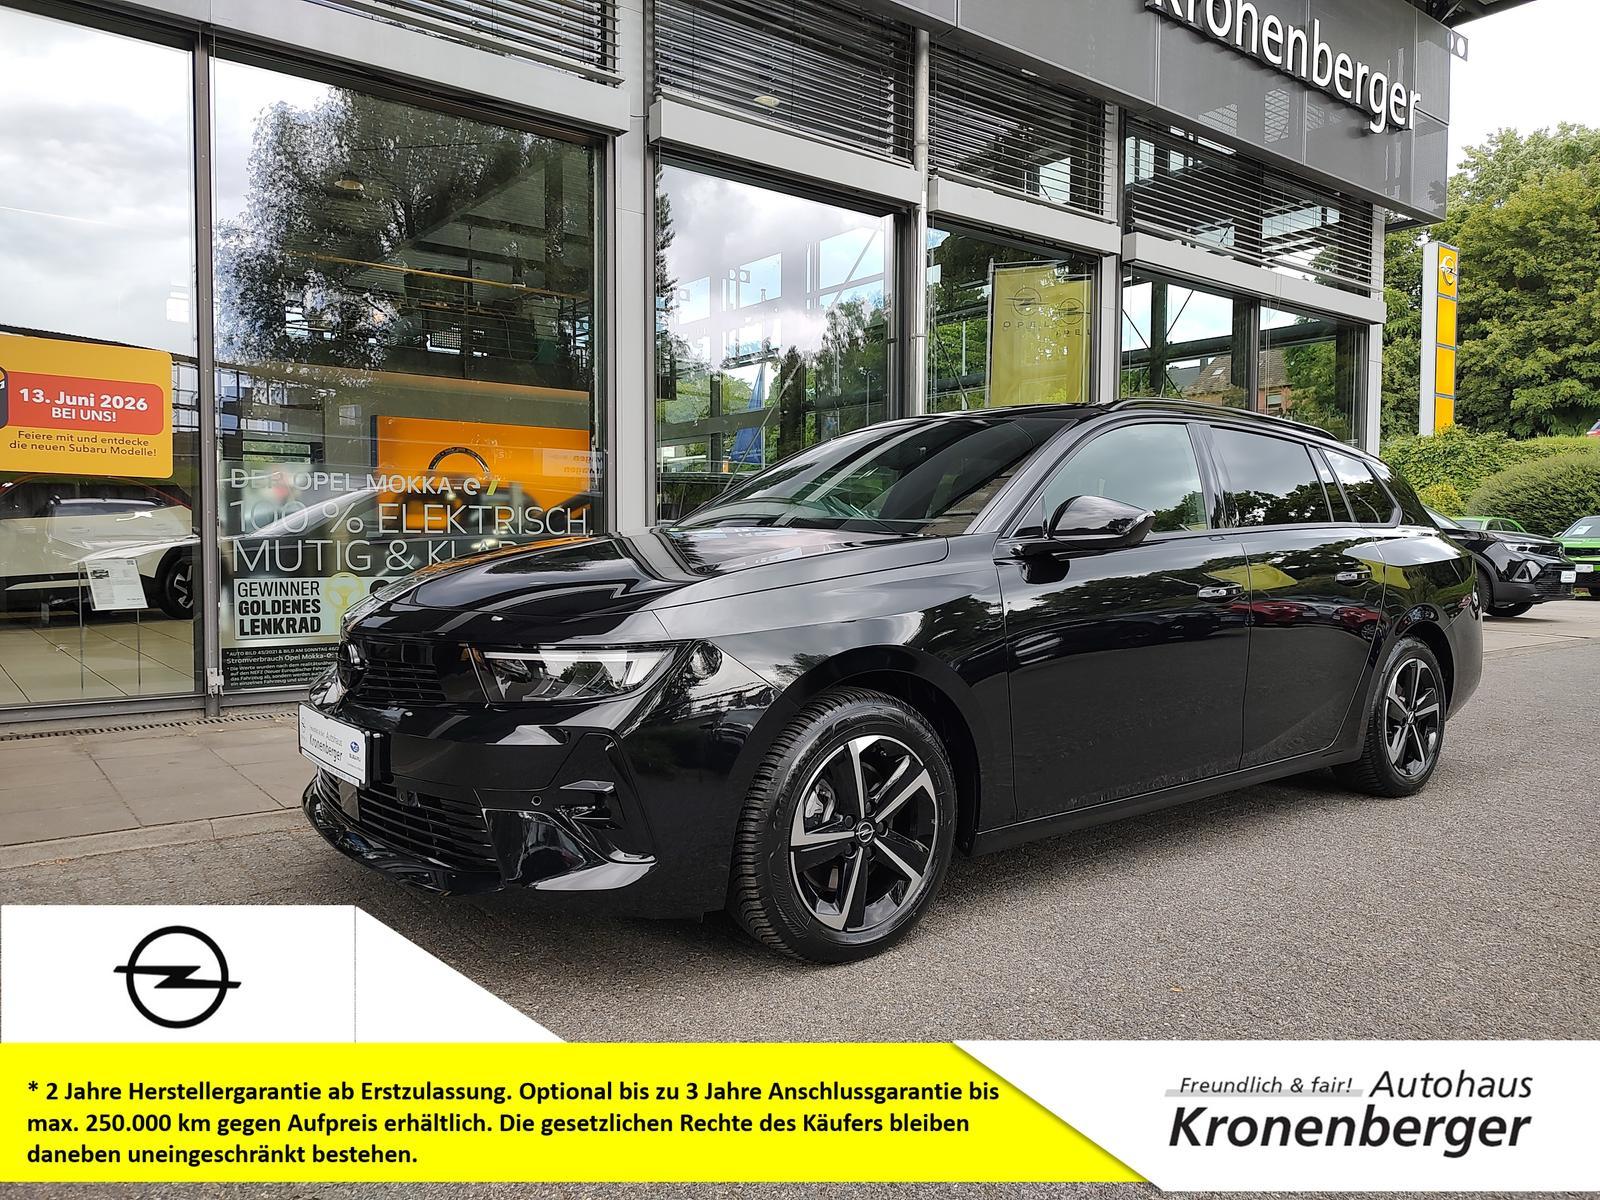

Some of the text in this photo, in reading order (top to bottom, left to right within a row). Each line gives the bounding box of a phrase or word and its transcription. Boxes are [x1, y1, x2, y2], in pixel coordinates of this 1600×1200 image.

[1153, 0, 1421, 134] onenberger
[19, 388, 149, 412] 13. Juni 2026
[51, 407, 117, 423] BEI UNS!
[17, 430, 150, 447] Feiere mit und entdecke
[9, 440, 157, 457] die neuen Subaru Modelle!
[292, 471, 358, 493] OPEL
[230, 500, 593, 538] 100 % ELEKTRISCH,
[233, 539, 518, 572] MUTIG & KL
[237, 580, 320, 598] GEWINNER
[238, 598, 321, 616] GOLDENES
[239, 616, 321, 636] LENKRAD
[226, 655, 284, 665] Stromverbrauch
[284, 654, 301, 662] Opel
